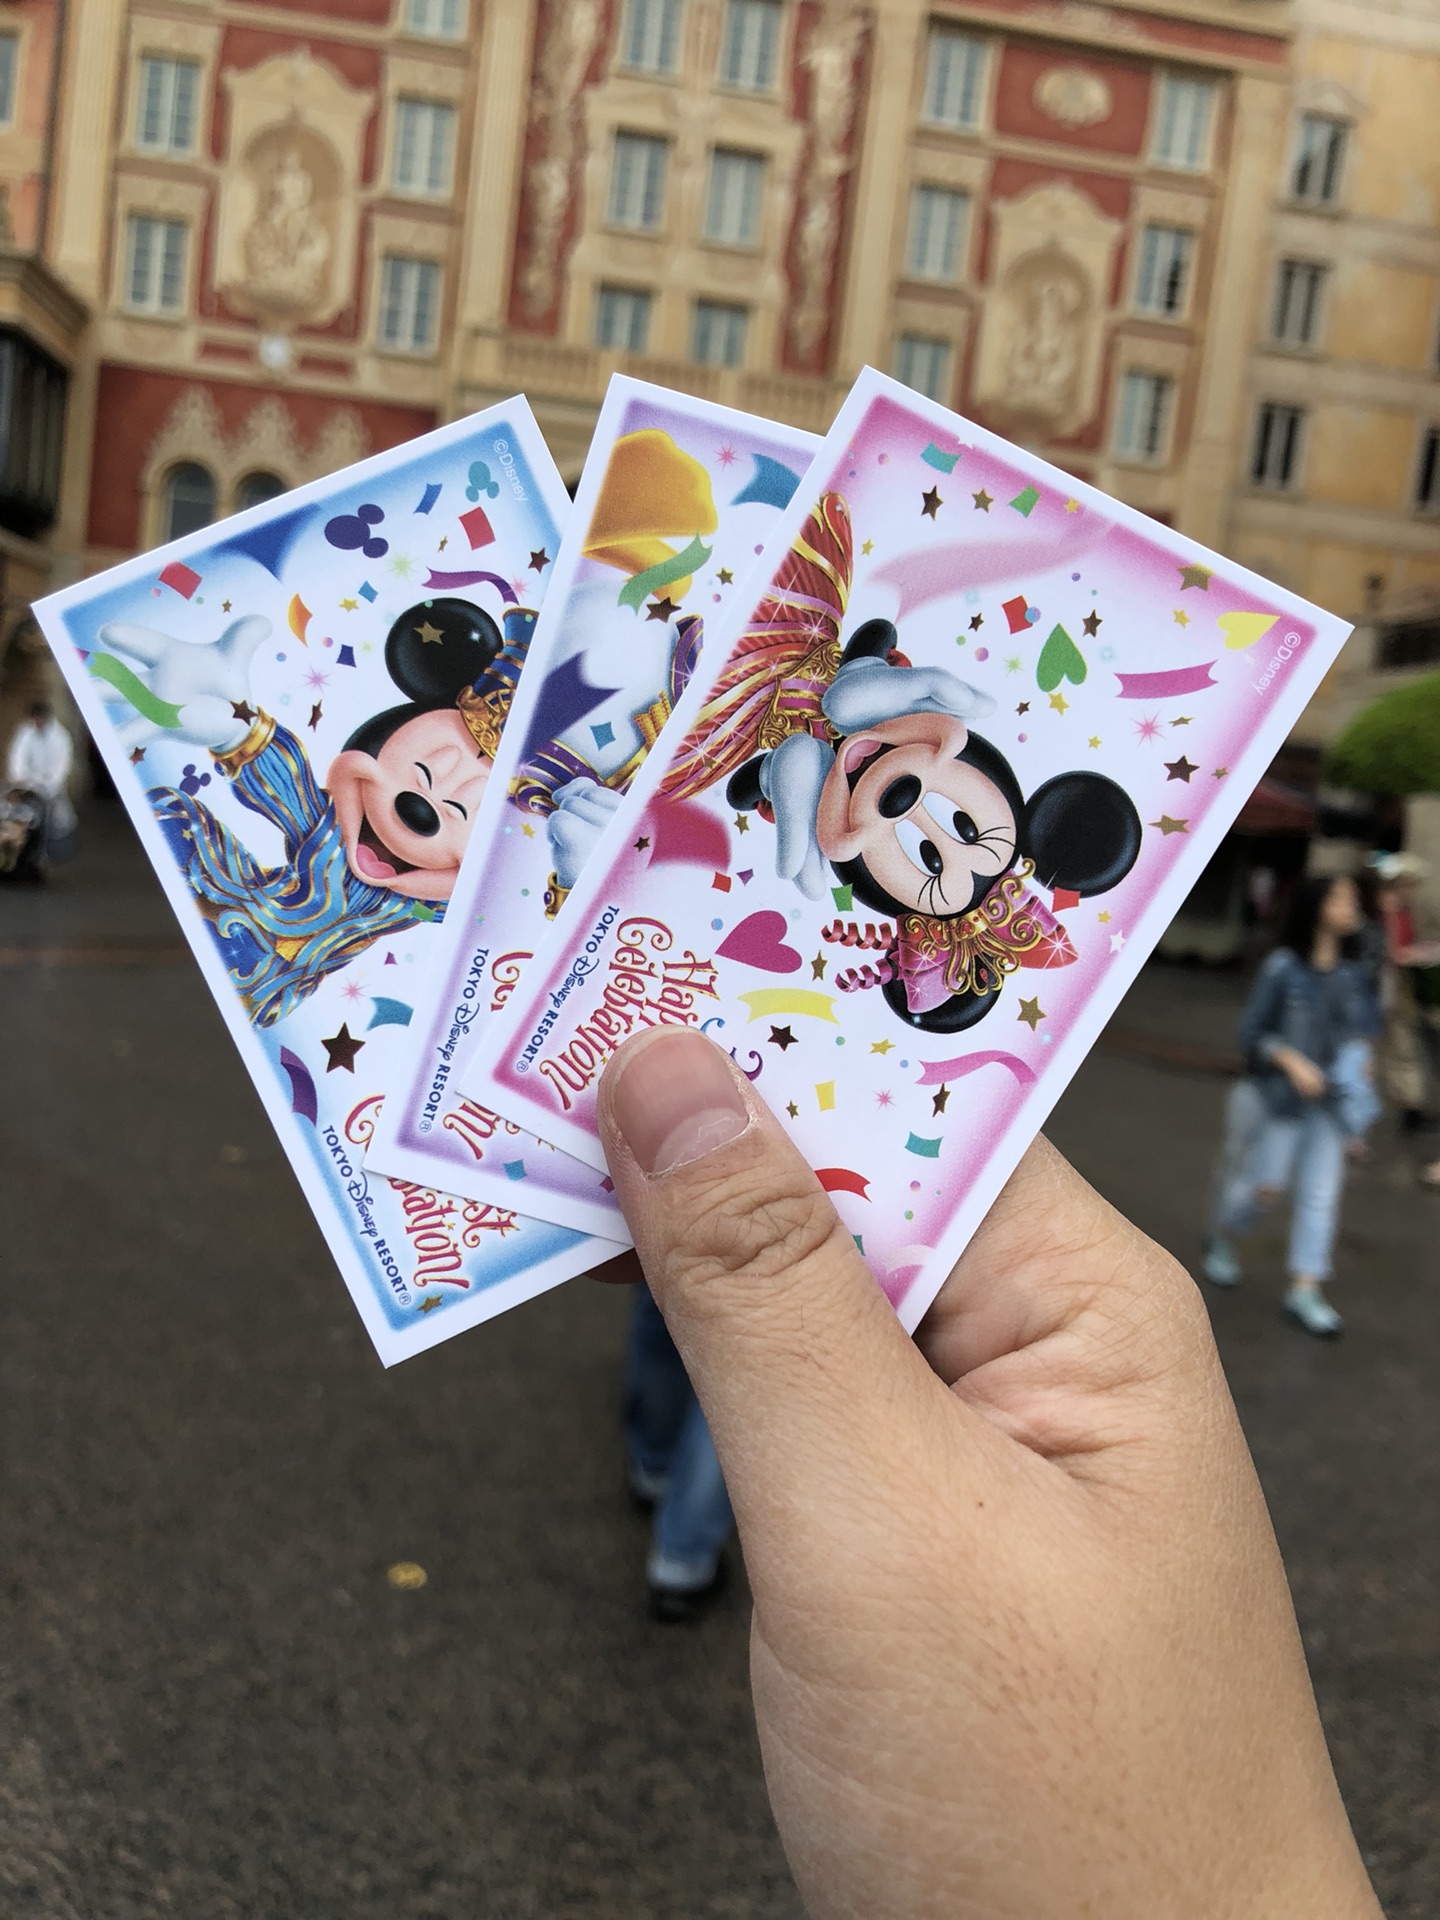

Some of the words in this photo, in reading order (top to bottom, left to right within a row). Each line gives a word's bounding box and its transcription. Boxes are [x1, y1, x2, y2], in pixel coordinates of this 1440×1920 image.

[1252, 632, 1302, 696] ©Disney
[585, 905, 620, 954] TOKYO
[463, 948, 490, 1000] TOKYO
[539, 917, 674, 1111] Celebration!
[322, 1124, 354, 1178] TOKYO
